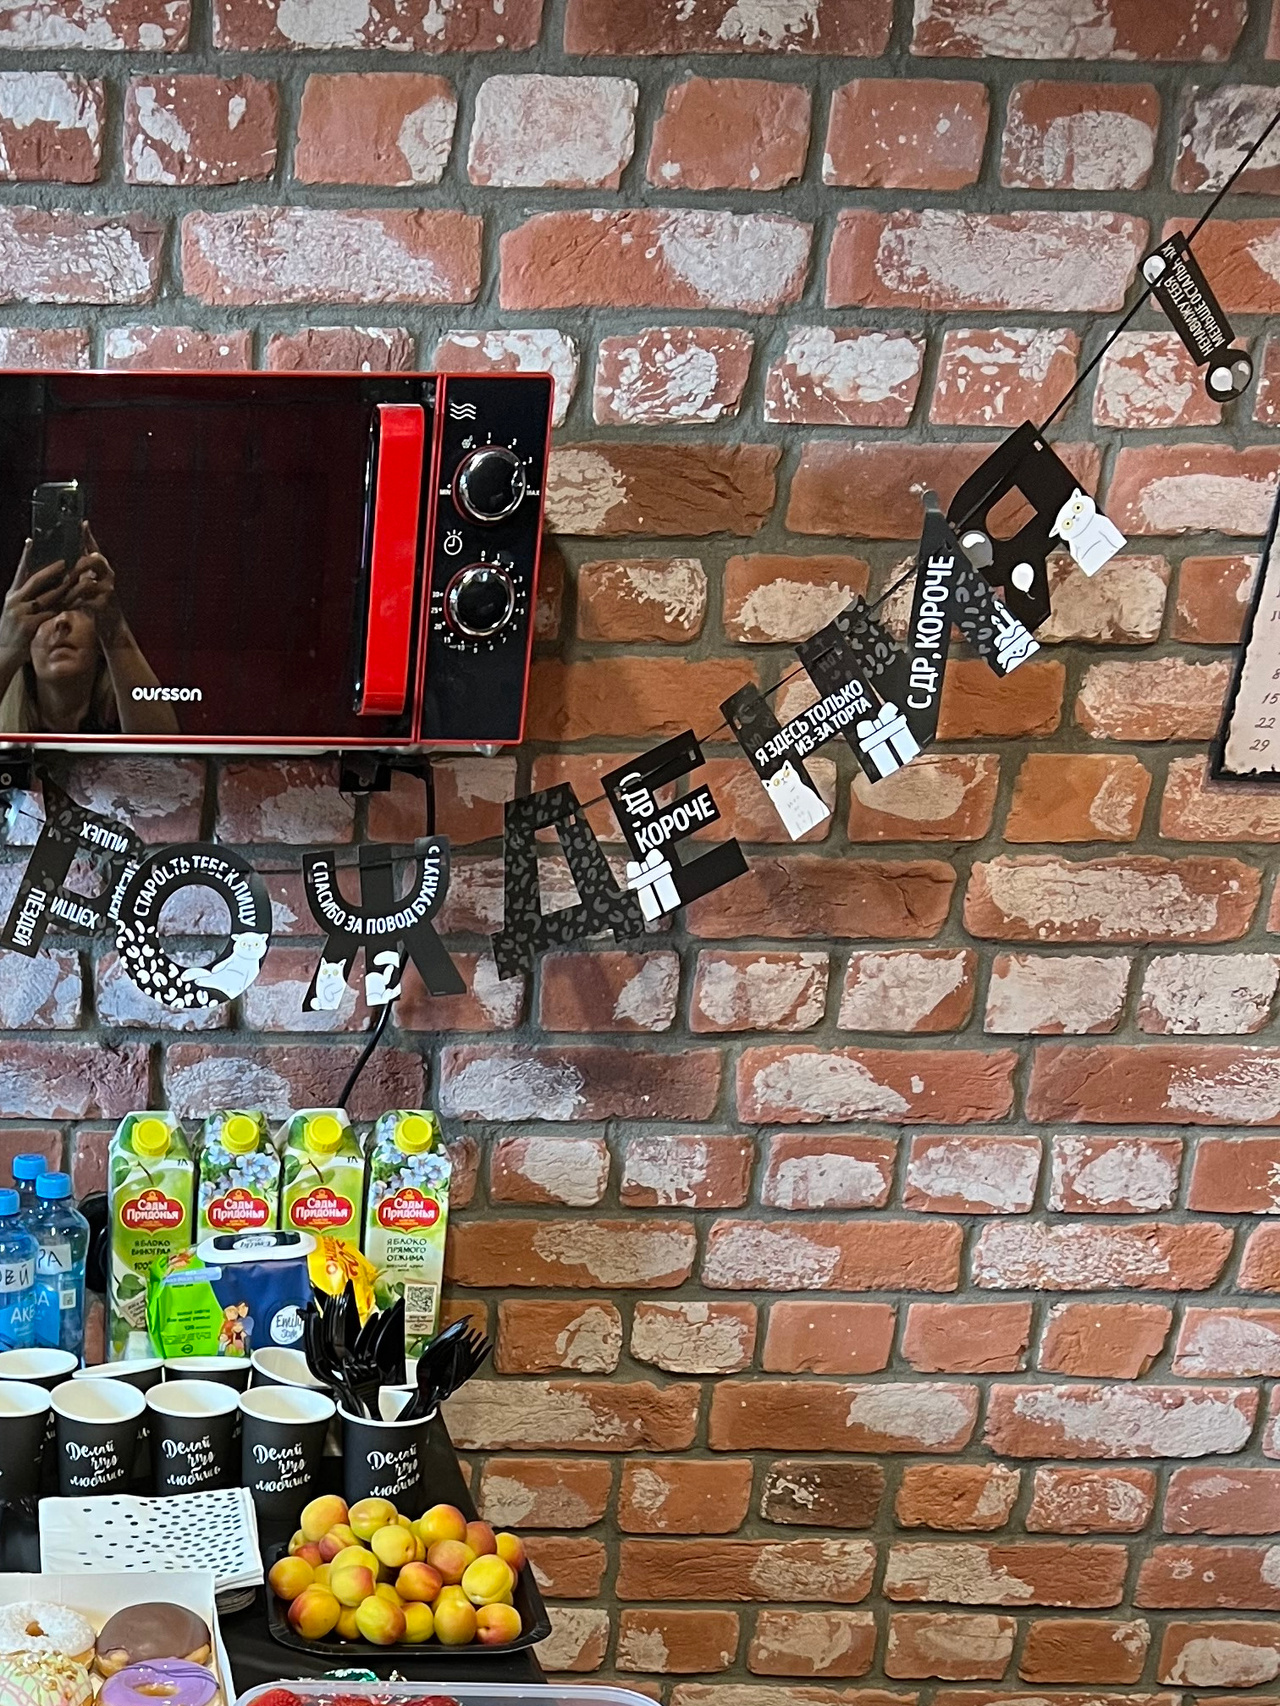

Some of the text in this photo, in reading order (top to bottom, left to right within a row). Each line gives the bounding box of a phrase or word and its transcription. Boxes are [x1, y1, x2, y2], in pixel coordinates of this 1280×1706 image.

[1163, 275, 1186, 305] ТЕБЯ
[914, 555, 955, 651] КОРОЧЕ
[131, 686, 203, 701] oursson
[906, 694, 933, 709] С
[755, 679, 864, 767] Я ЗДЕСЬ ТОЛЬКО
[794, 696, 873, 757] ИЗ-ЗА ТОРТА
[1255, 717, 1276, 729] 22
[1249, 739, 1271, 752] 29
[633, 792, 716, 854] КОРОЧЕ
[80, 822, 128, 853] ХЭППИ
[231, 880, 257, 927] ЛИЦУ
[312, 861, 346, 926] СПАСИБО
[344, 915, 363, 934] ЗА
[366, 907, 418, 935] ПОВОД
[137, 1199, 167, 1211] Сады
[224, 1199, 254, 1211] Сады
[307, 1198, 337, 1210] Сады
[394, 1198, 424, 1210] Сады
[127, 1208, 179, 1221] Придонья
[213, 1208, 265, 1221] Придонья
[295, 1206, 348, 1220] Придонья
[383, 1207, 435, 1221] Придонья
[387, 1238, 427, 1246] ЯБЛОКО
